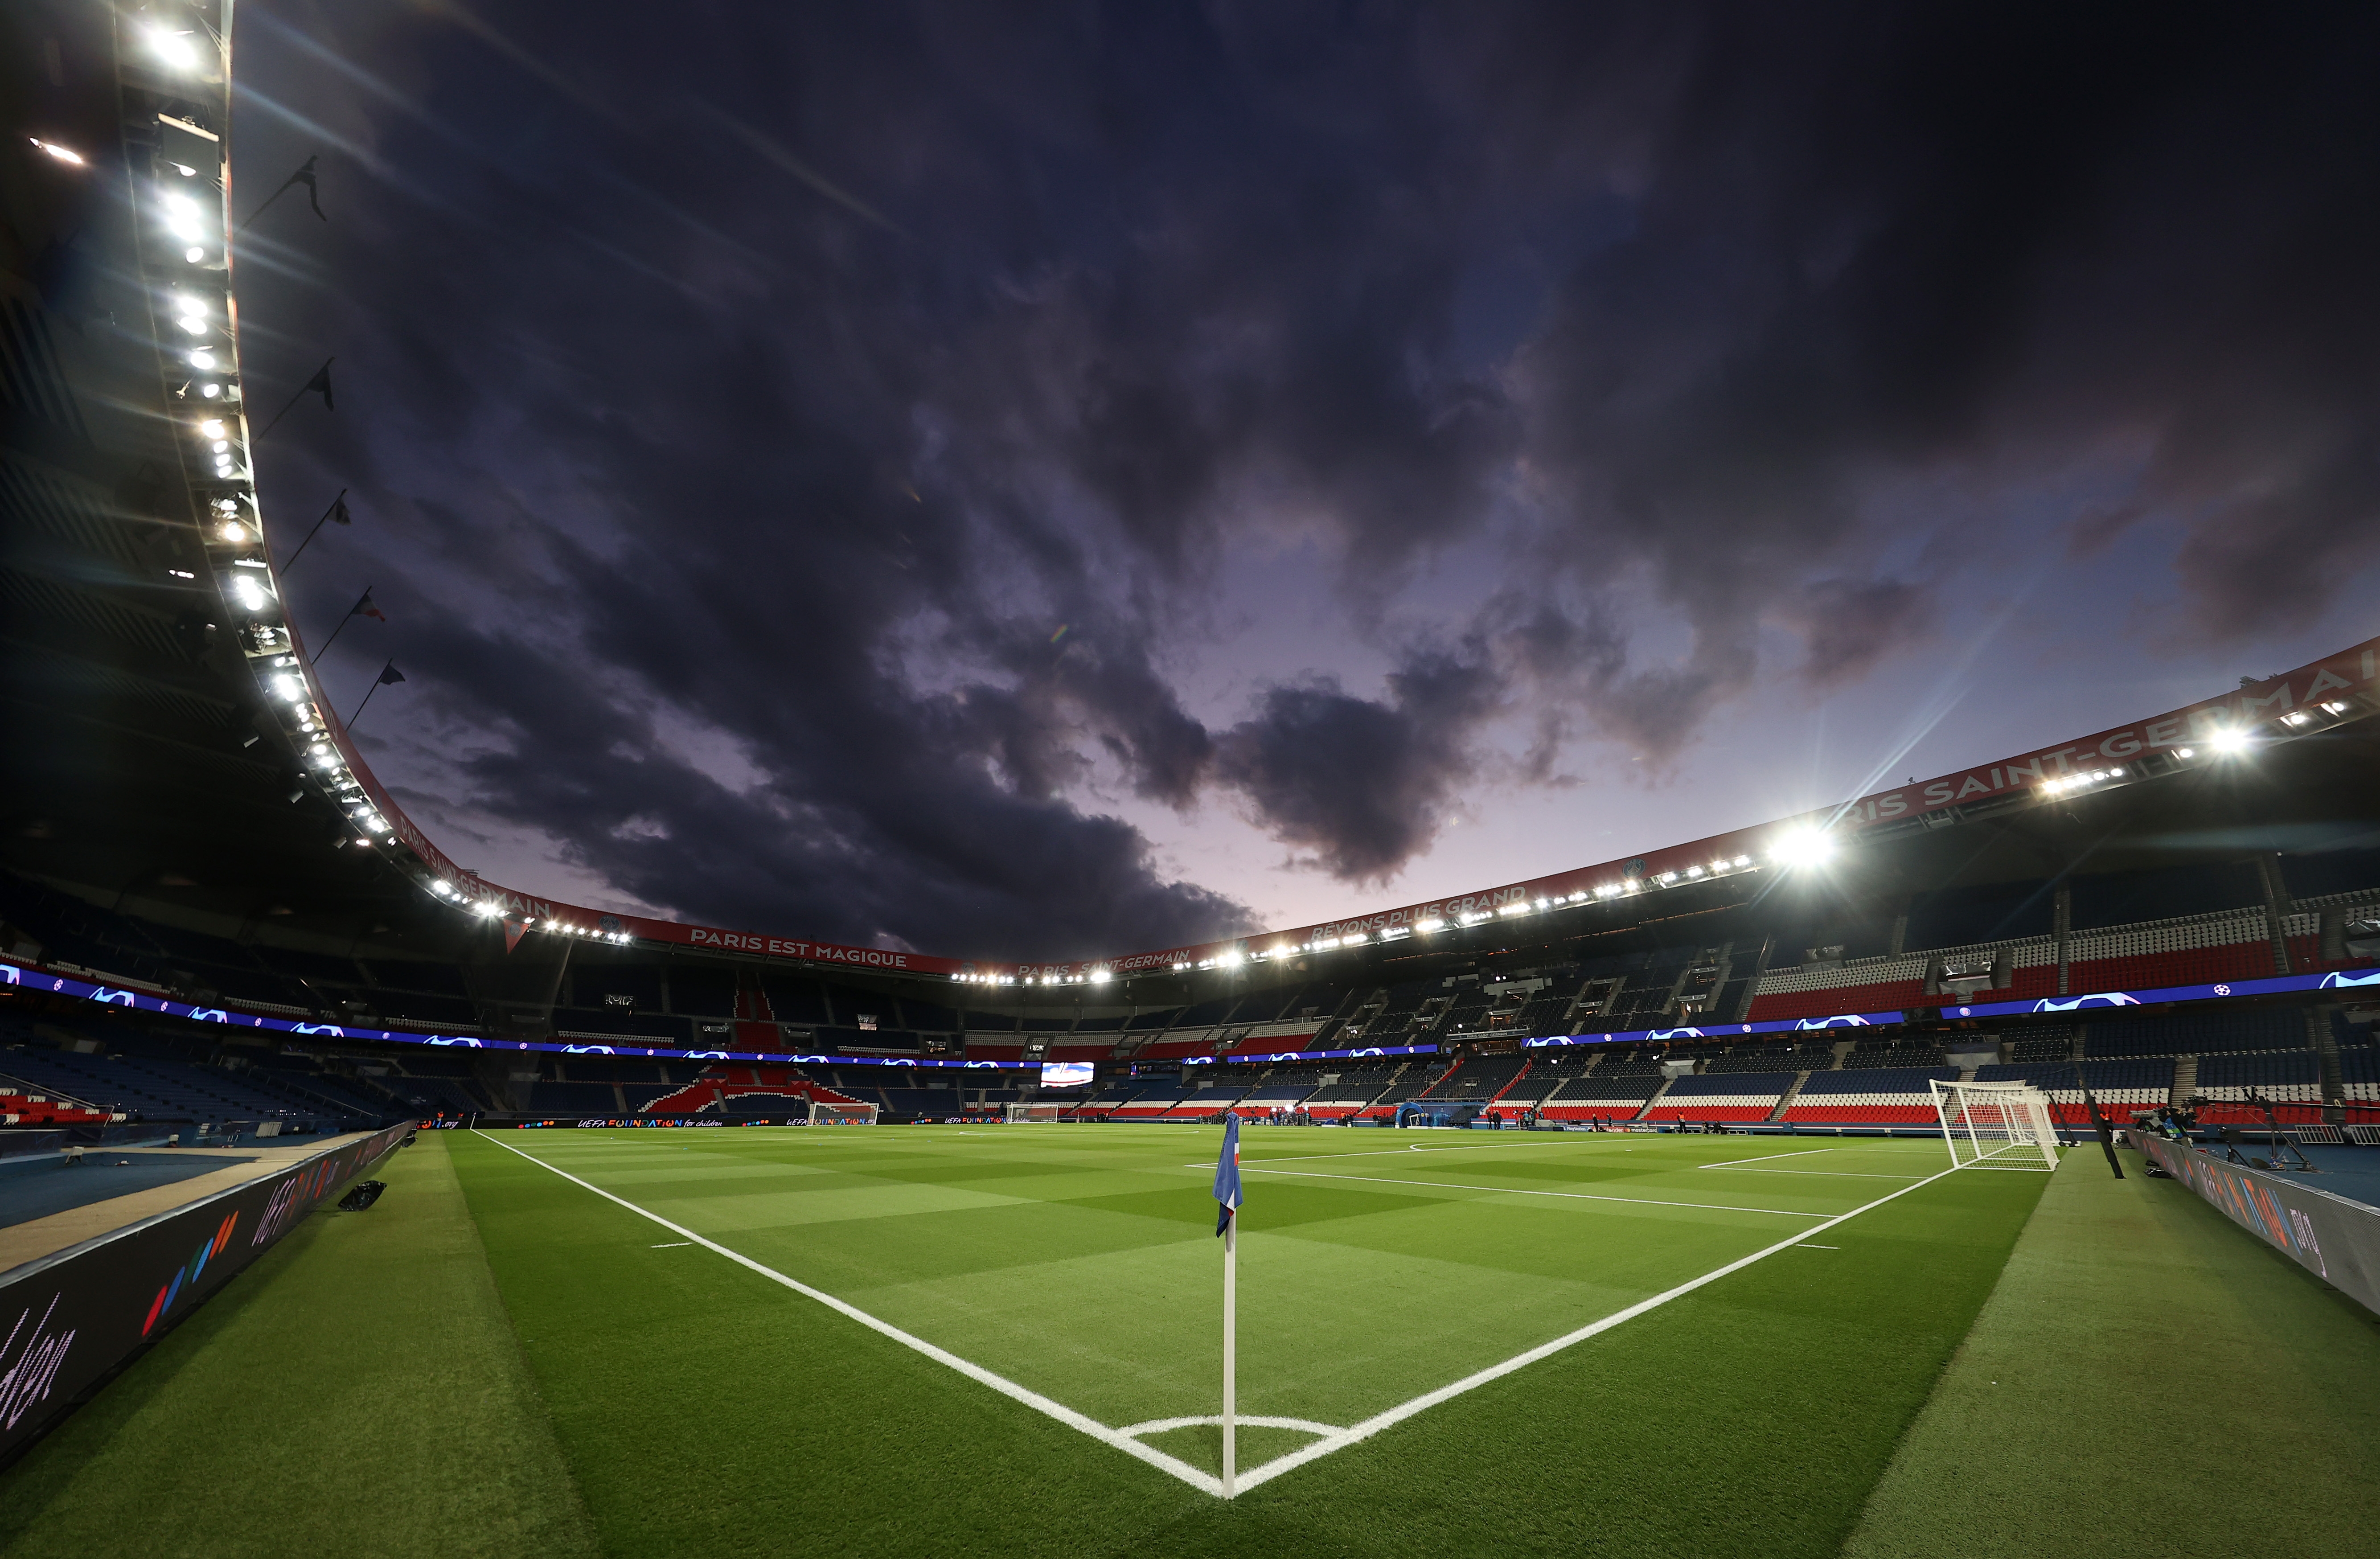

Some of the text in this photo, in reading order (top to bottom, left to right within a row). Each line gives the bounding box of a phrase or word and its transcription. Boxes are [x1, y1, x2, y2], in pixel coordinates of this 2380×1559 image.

[1840, 649, 2375, 829] RIS SAINT-GERMAI
[401, 816, 550, 917] PARIS SAINT-GERMAIN
[1310, 886, 1526, 940] RÊVONS PLUS GRAND
[690, 929, 907, 968] PARIS EST MAGIQUE
[1018, 949, 1190, 976] PARIS SAINT-GERMAIN
[578, 1119, 606, 1127] UEFA
[608, 1119, 683, 1127] FOUNDATION
[683, 1119, 695, 1128] for
[251, 1177, 296, 1247] UEFA
